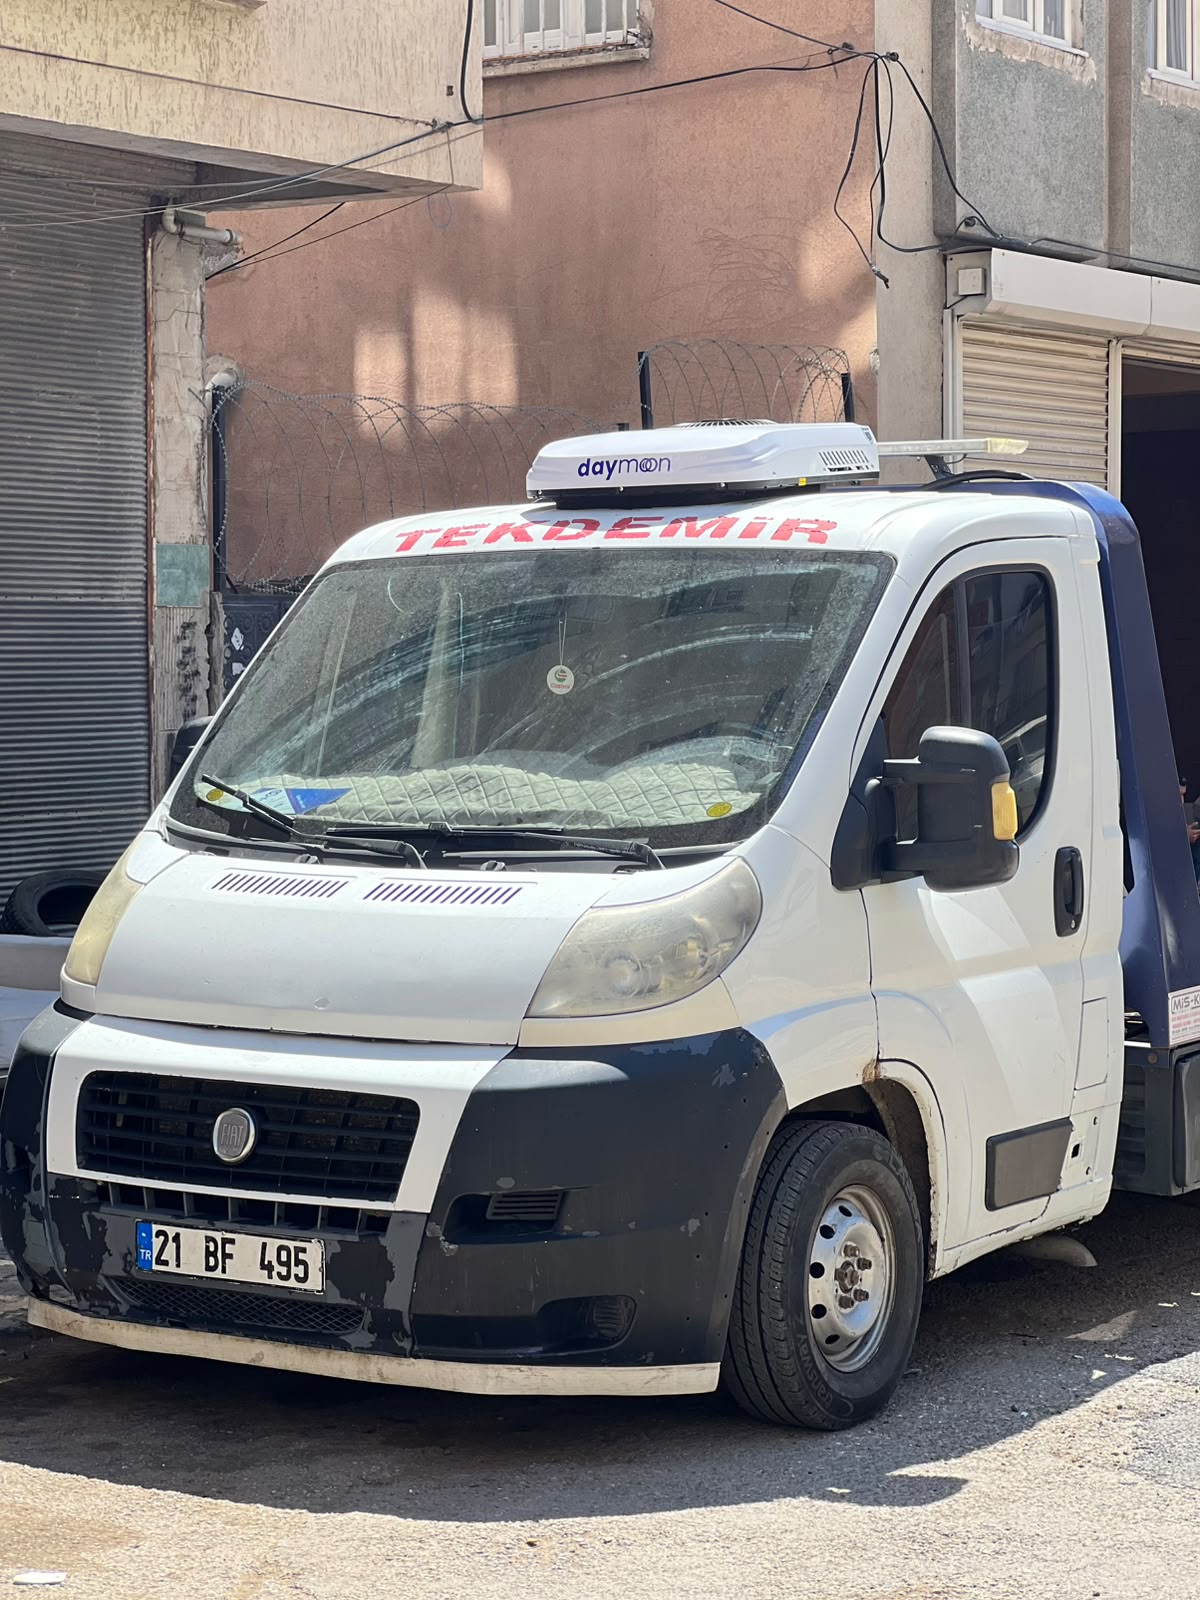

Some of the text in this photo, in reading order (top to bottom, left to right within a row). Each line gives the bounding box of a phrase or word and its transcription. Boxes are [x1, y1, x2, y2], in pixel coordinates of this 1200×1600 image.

[576, 456, 671, 481] daymoon
[221, 1123, 244, 1146] FIAT
[139, 1229, 309, 1285] TR 21 BF 495
